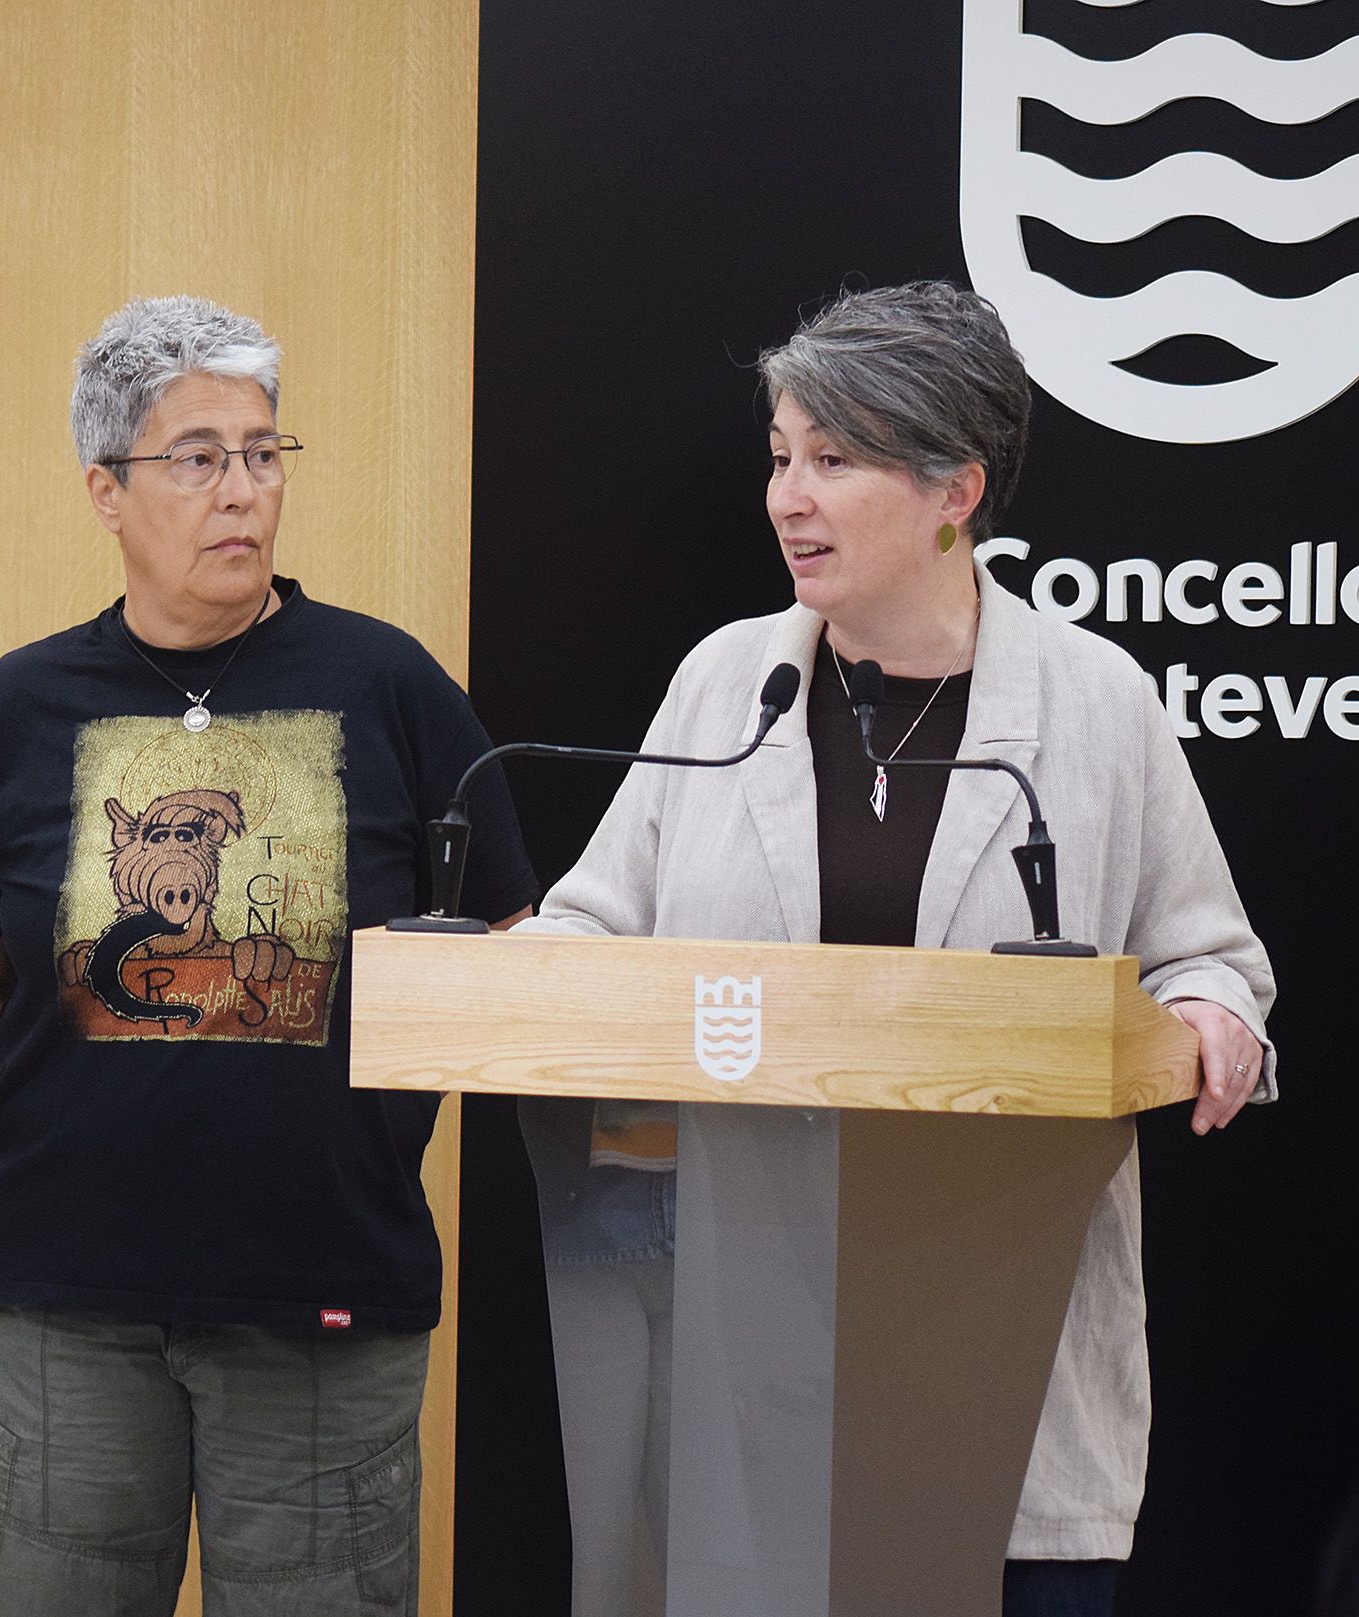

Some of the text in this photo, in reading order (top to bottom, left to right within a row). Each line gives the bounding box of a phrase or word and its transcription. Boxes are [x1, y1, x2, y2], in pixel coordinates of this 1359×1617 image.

[973, 537, 1359, 627] oncell
[1144, 663, 1359, 741] teve
[297, 963, 323, 979] DE
